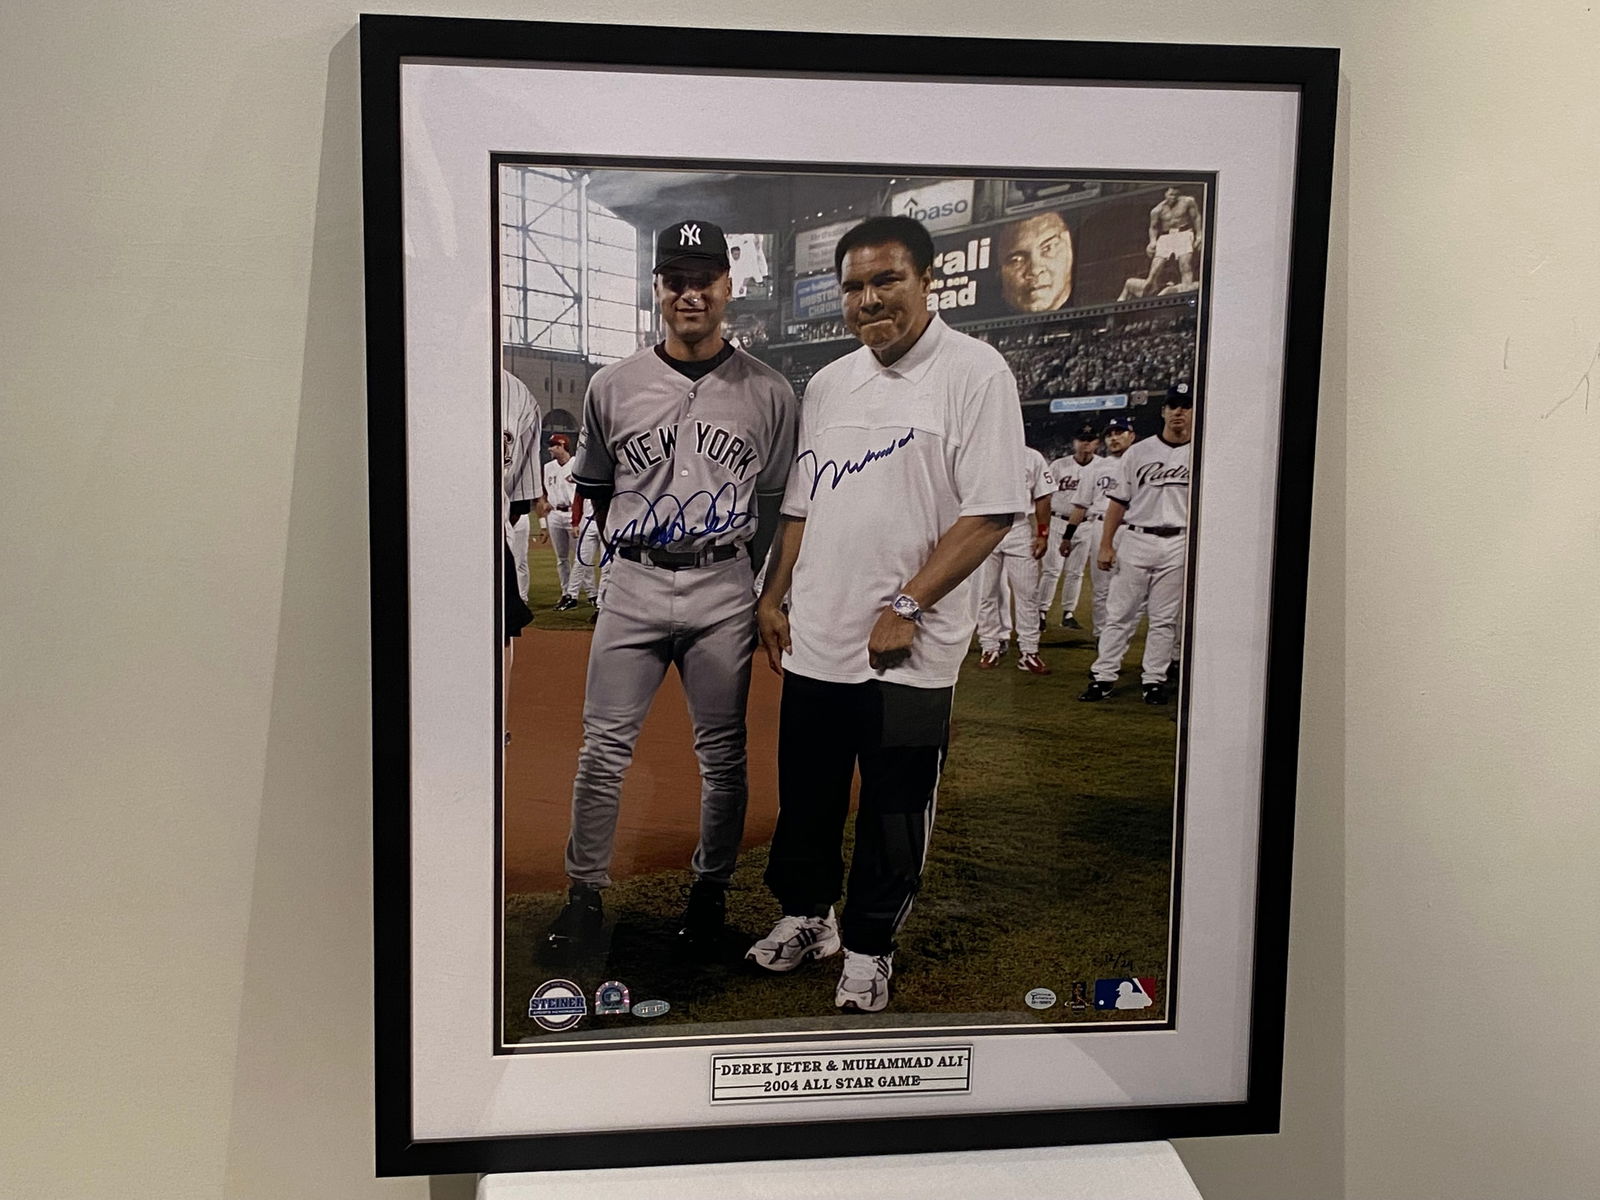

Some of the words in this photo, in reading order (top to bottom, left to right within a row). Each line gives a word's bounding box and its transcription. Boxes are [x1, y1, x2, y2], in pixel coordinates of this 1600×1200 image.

[926, 281, 976, 311] aad
[622, 424, 680, 476] NEW
[695, 421, 759, 480] YORK
[531, 997, 584, 1009] STEINER
[720, 1063, 773, 1076] DEREK
[775, 1061, 822, 1076] JETER
[826, 1060, 838, 1071] &
[842, 1057, 934, 1071] MUHAMMAD
[937, 1055, 964, 1067] ALI
[764, 1080, 799, 1092] 2004
[802, 1078, 832, 1090] ALL
[835, 1077, 874, 1089] STAR
[878, 1075, 921, 1087] GAME
